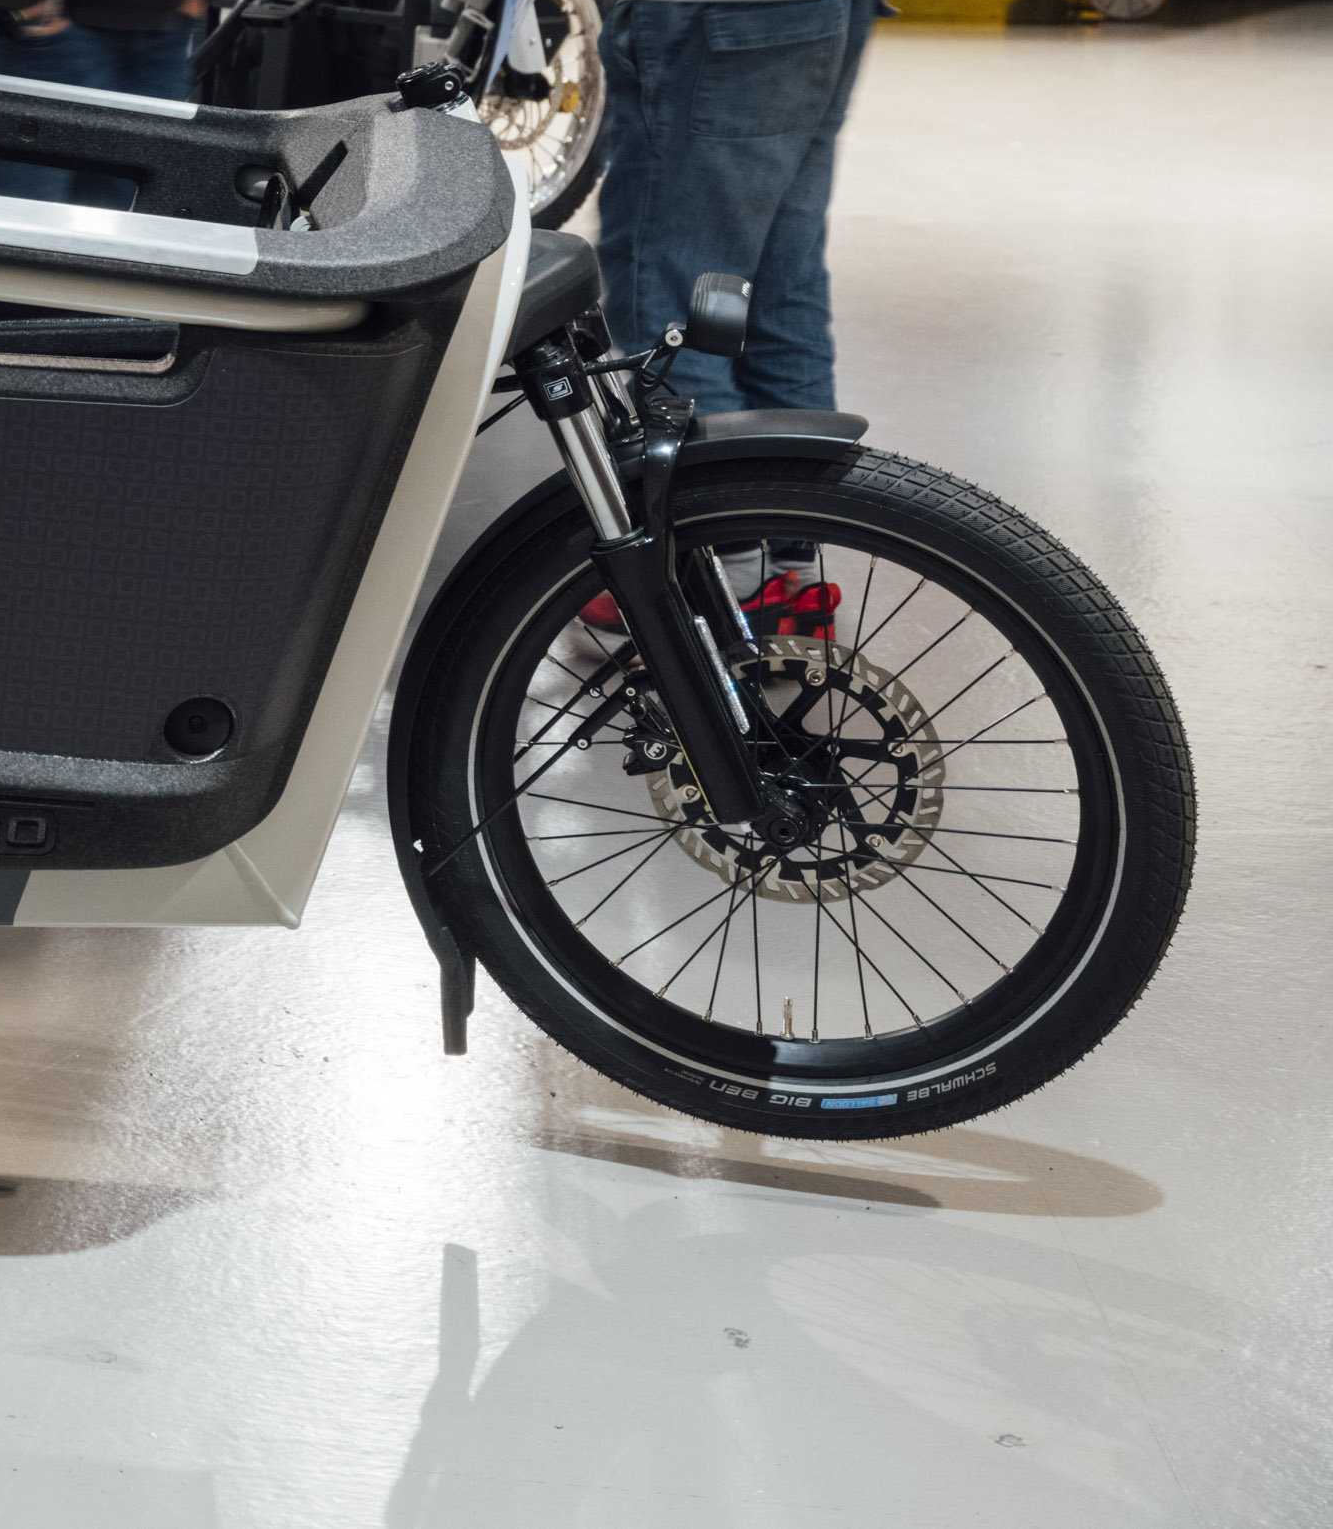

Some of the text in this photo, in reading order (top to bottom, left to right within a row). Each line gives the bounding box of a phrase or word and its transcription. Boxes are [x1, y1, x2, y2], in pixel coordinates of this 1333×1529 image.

[710, 1080, 759, 1101] BEN
[906, 1062, 997, 1102] SCHWALBE
[769, 1095, 813, 1108] BIG
